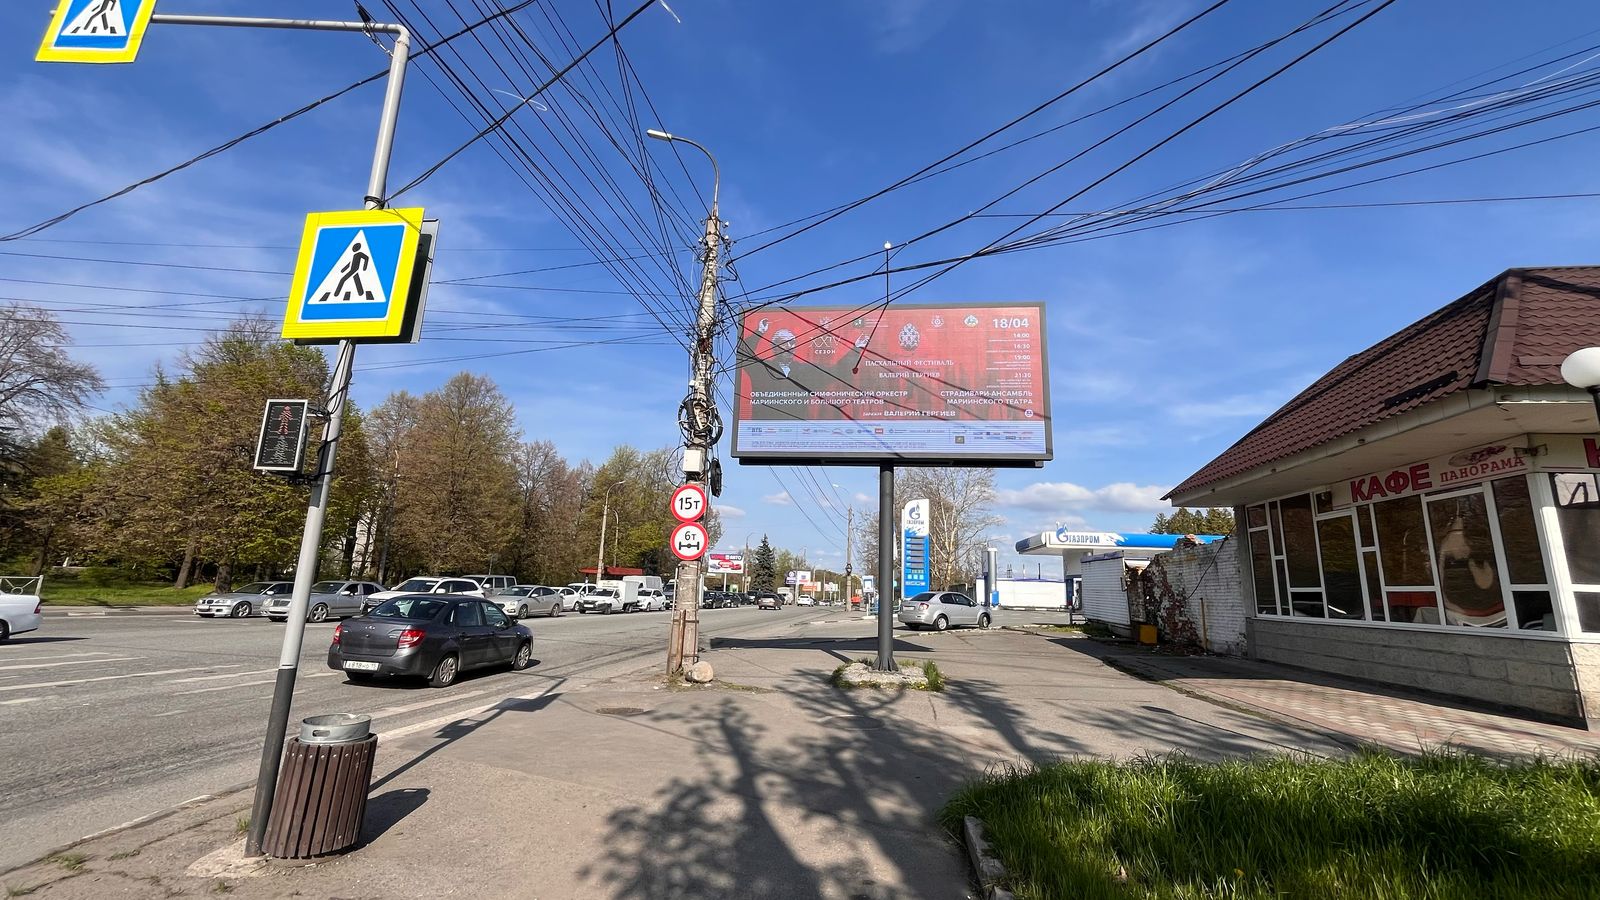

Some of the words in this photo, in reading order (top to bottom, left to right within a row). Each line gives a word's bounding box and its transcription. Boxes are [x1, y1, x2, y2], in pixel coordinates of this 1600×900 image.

[992, 317, 1030, 329] 18/04
[883, 409, 921, 417] ВАЛЕРИЙ
[1440, 456, 1526, 483] ПАНОРАМА
[1350, 463, 1432, 502] КАФЕ
[1069, 535, 1100, 544] ГАЗПРОМ
